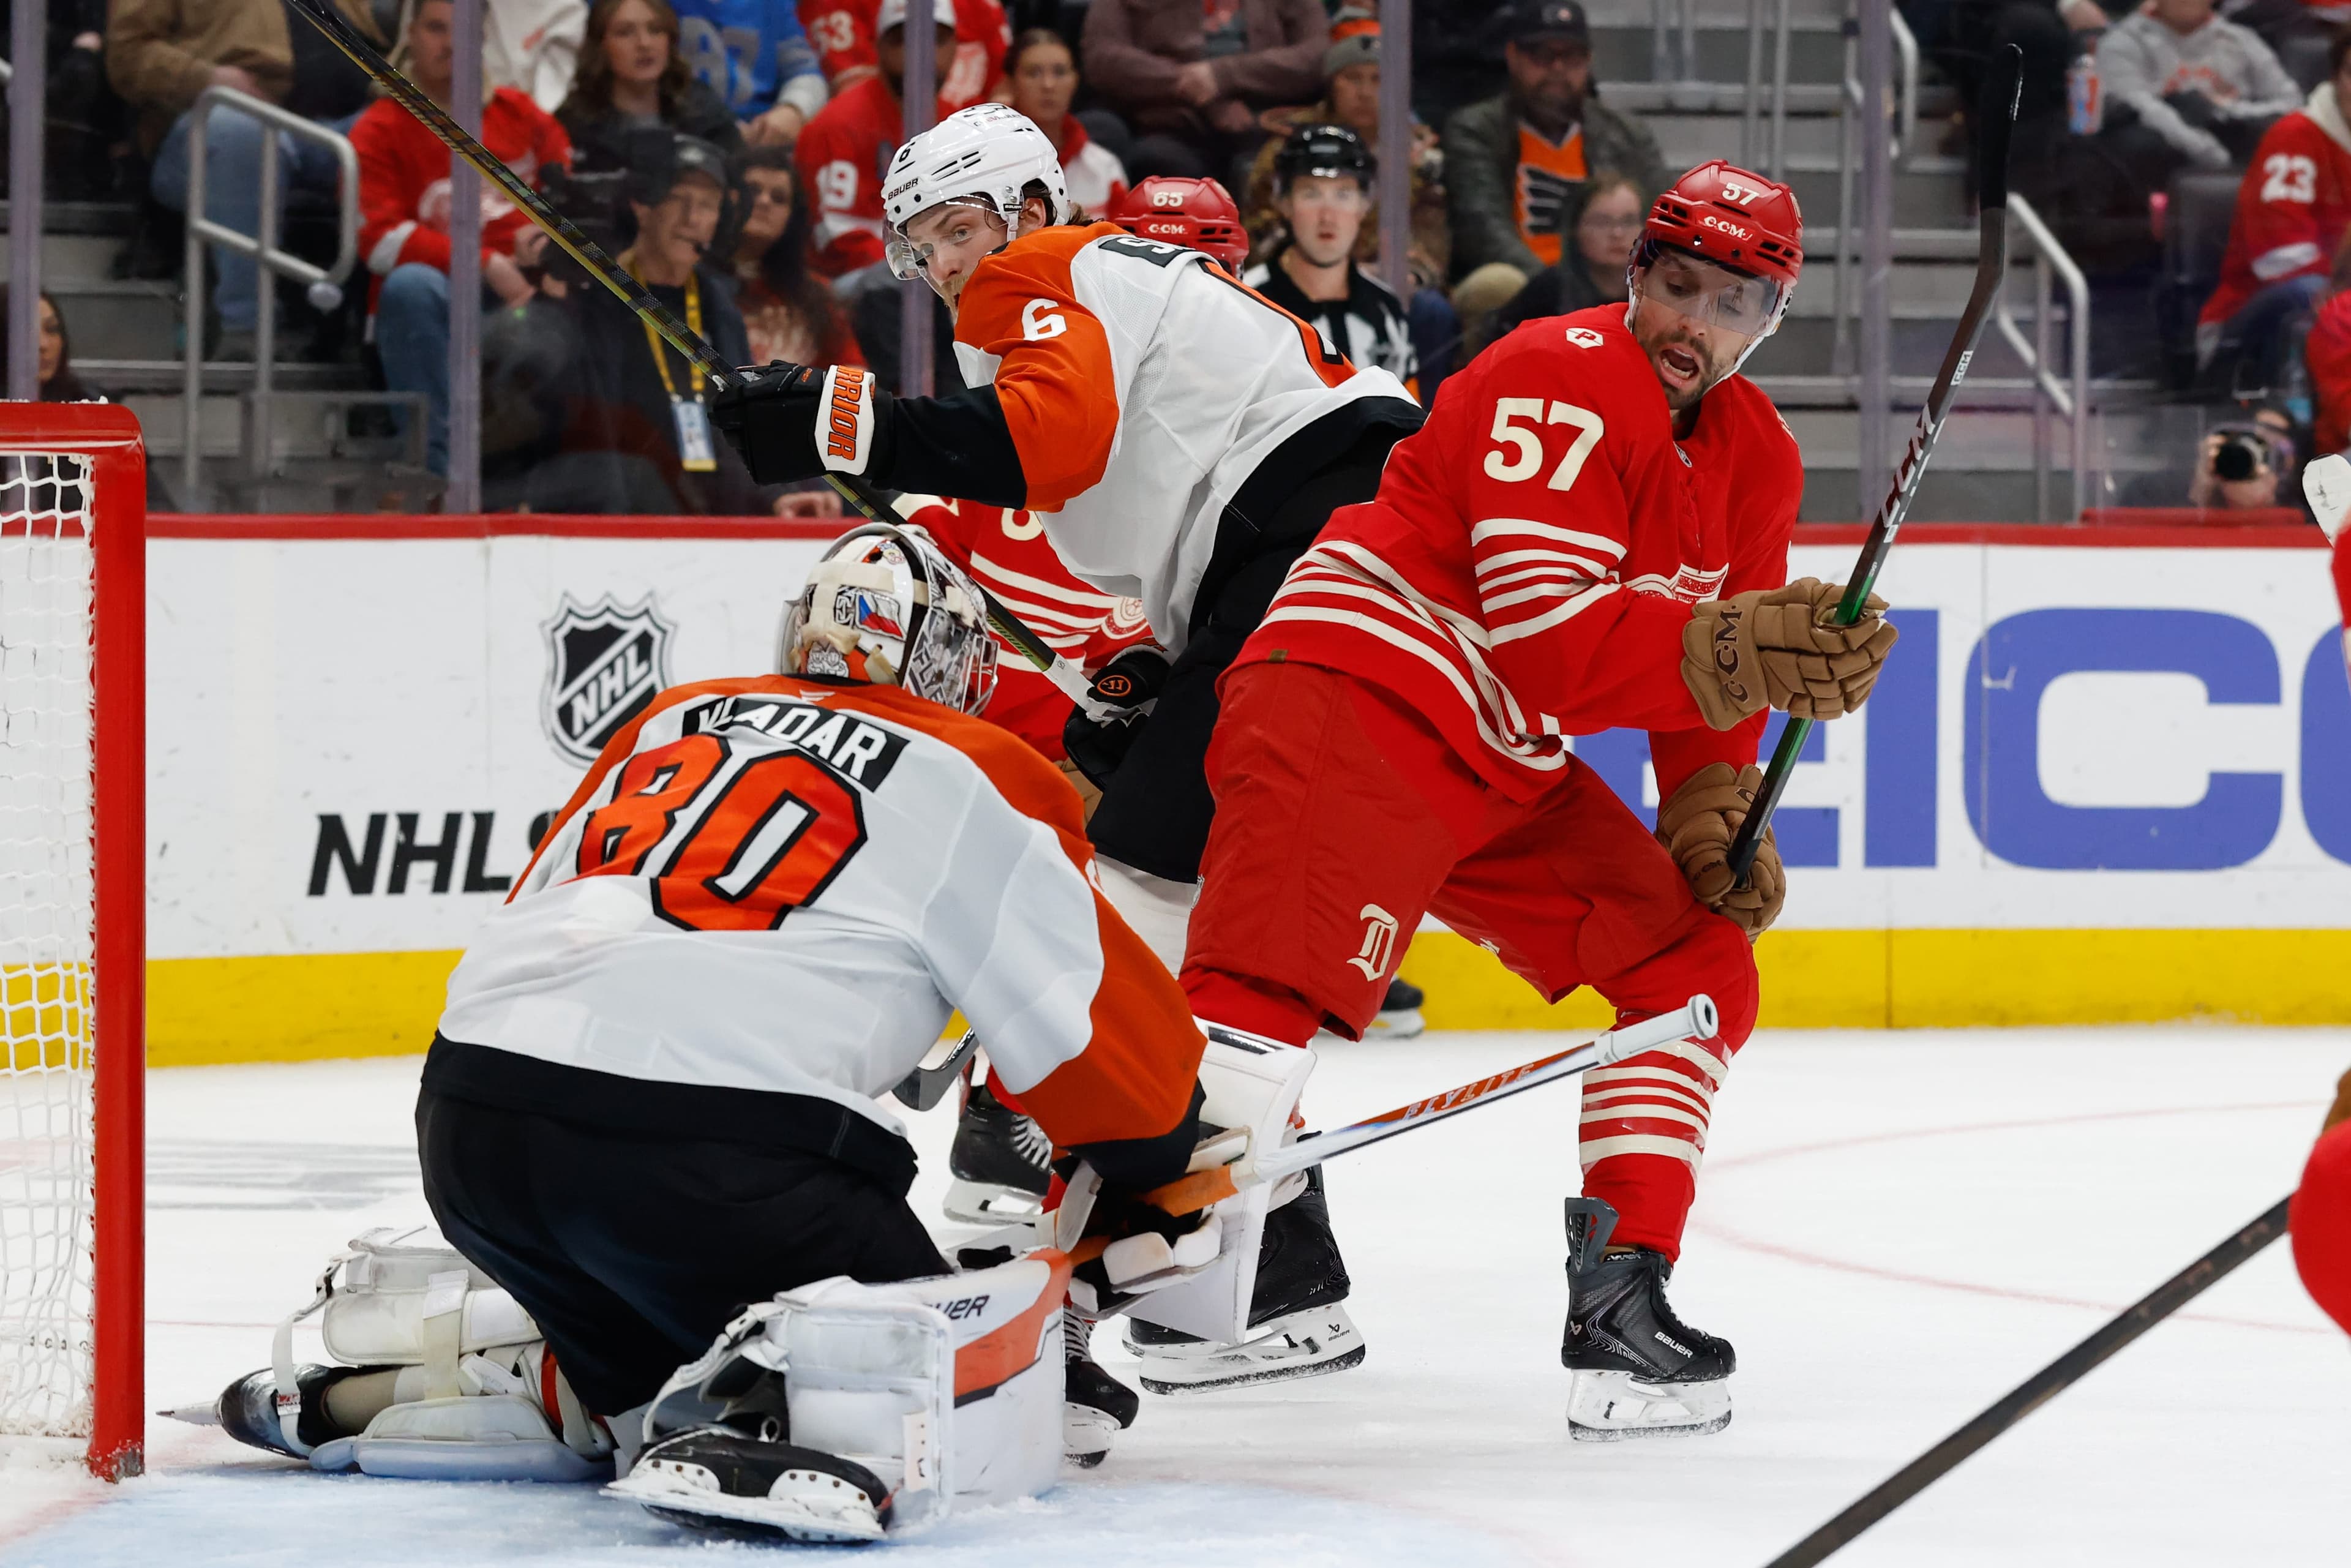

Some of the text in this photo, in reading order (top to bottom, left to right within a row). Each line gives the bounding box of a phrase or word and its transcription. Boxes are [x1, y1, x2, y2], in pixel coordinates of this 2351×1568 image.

[898, 141, 916, 163] 6
[816, 159, 857, 209] 19
[888, 178, 919, 201] BAUER
[1153, 191, 1184, 208] 65
[1722, 182, 1760, 206] 57
[2260, 154, 2317, 203] 23
[1021, 298, 1067, 342] 6
[1952, 351, 1971, 385] CCM
[827, 365, 864, 461] RRIOR
[1483, 397, 1605, 492] 57
[569, 642, 650, 737] NHL
[698, 696, 888, 780] VLADAR
[305, 809, 558, 898] NHL
[577, 733, 868, 931] 80
[1347, 903, 1400, 982] D
[1328, 1329, 1351, 1341] BAUER
[1654, 1330, 1694, 1359] BAUER
